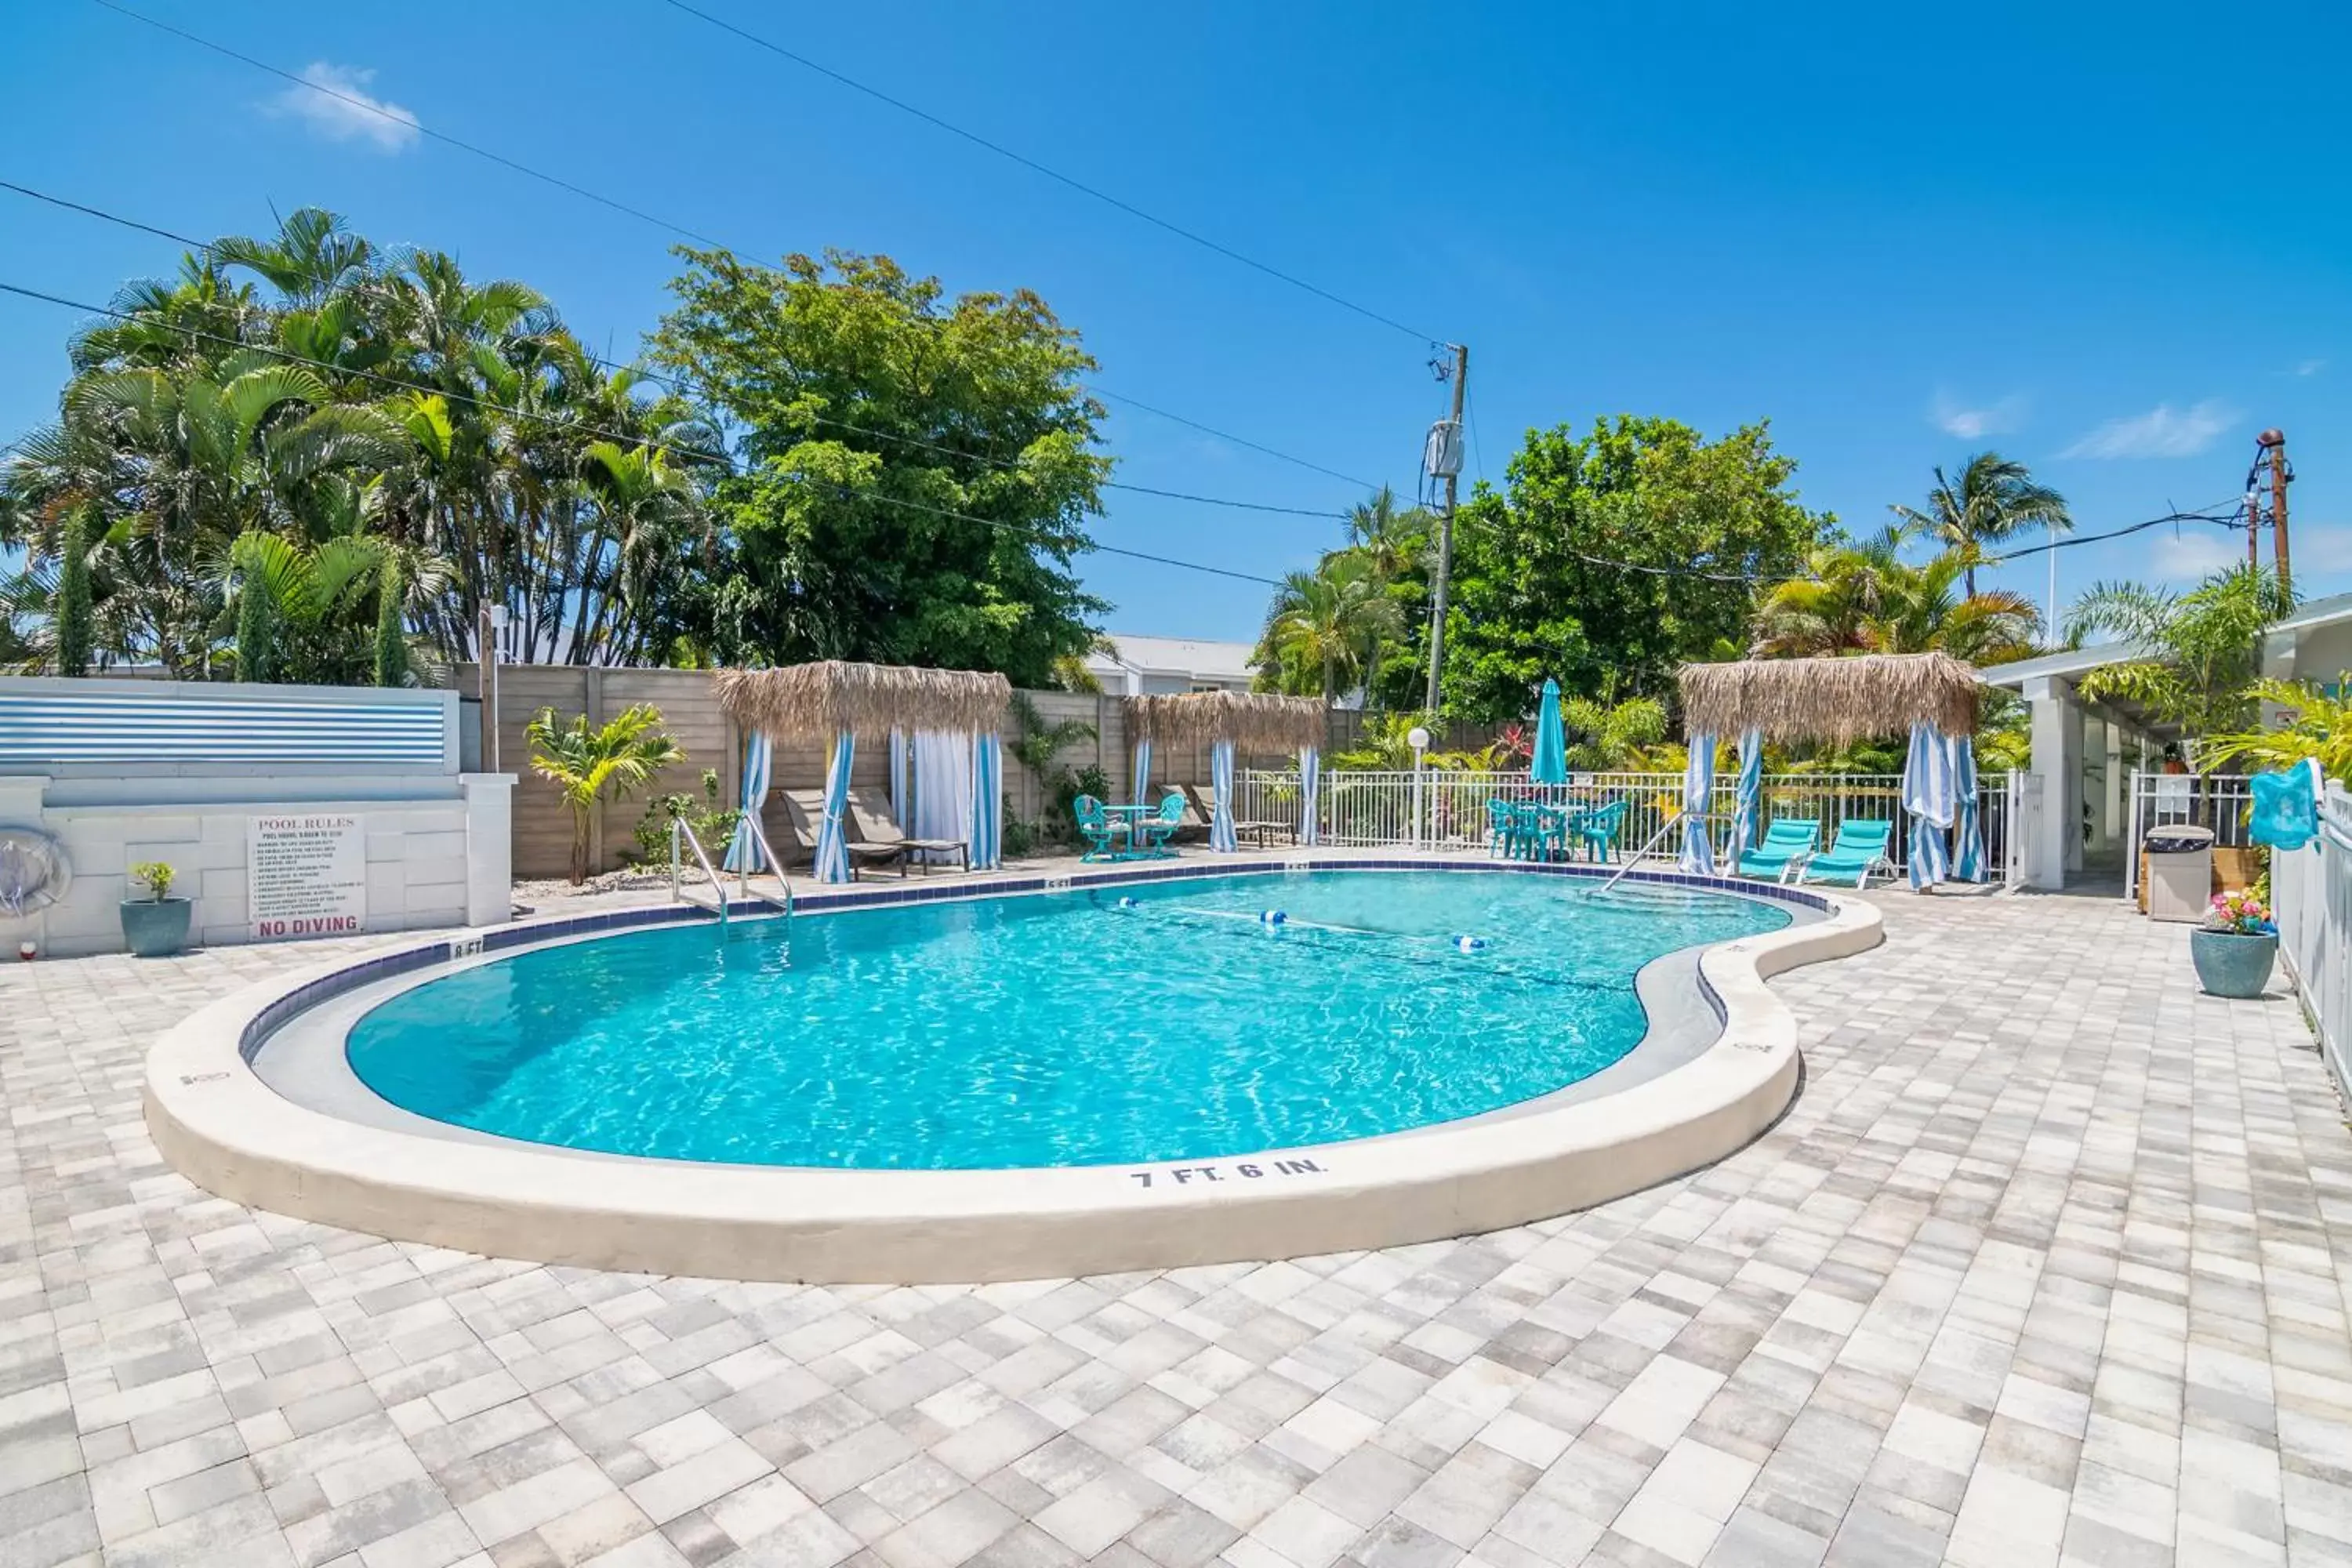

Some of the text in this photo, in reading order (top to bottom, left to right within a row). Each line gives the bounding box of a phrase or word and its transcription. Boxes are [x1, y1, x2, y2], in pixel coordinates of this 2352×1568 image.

[260, 818, 354, 830] POOL RULES
[260, 915, 357, 937] NO DIVING
[468, 940, 481, 955] FT
[1131, 1159, 1329, 1188] 7 FT. 6 IN.
